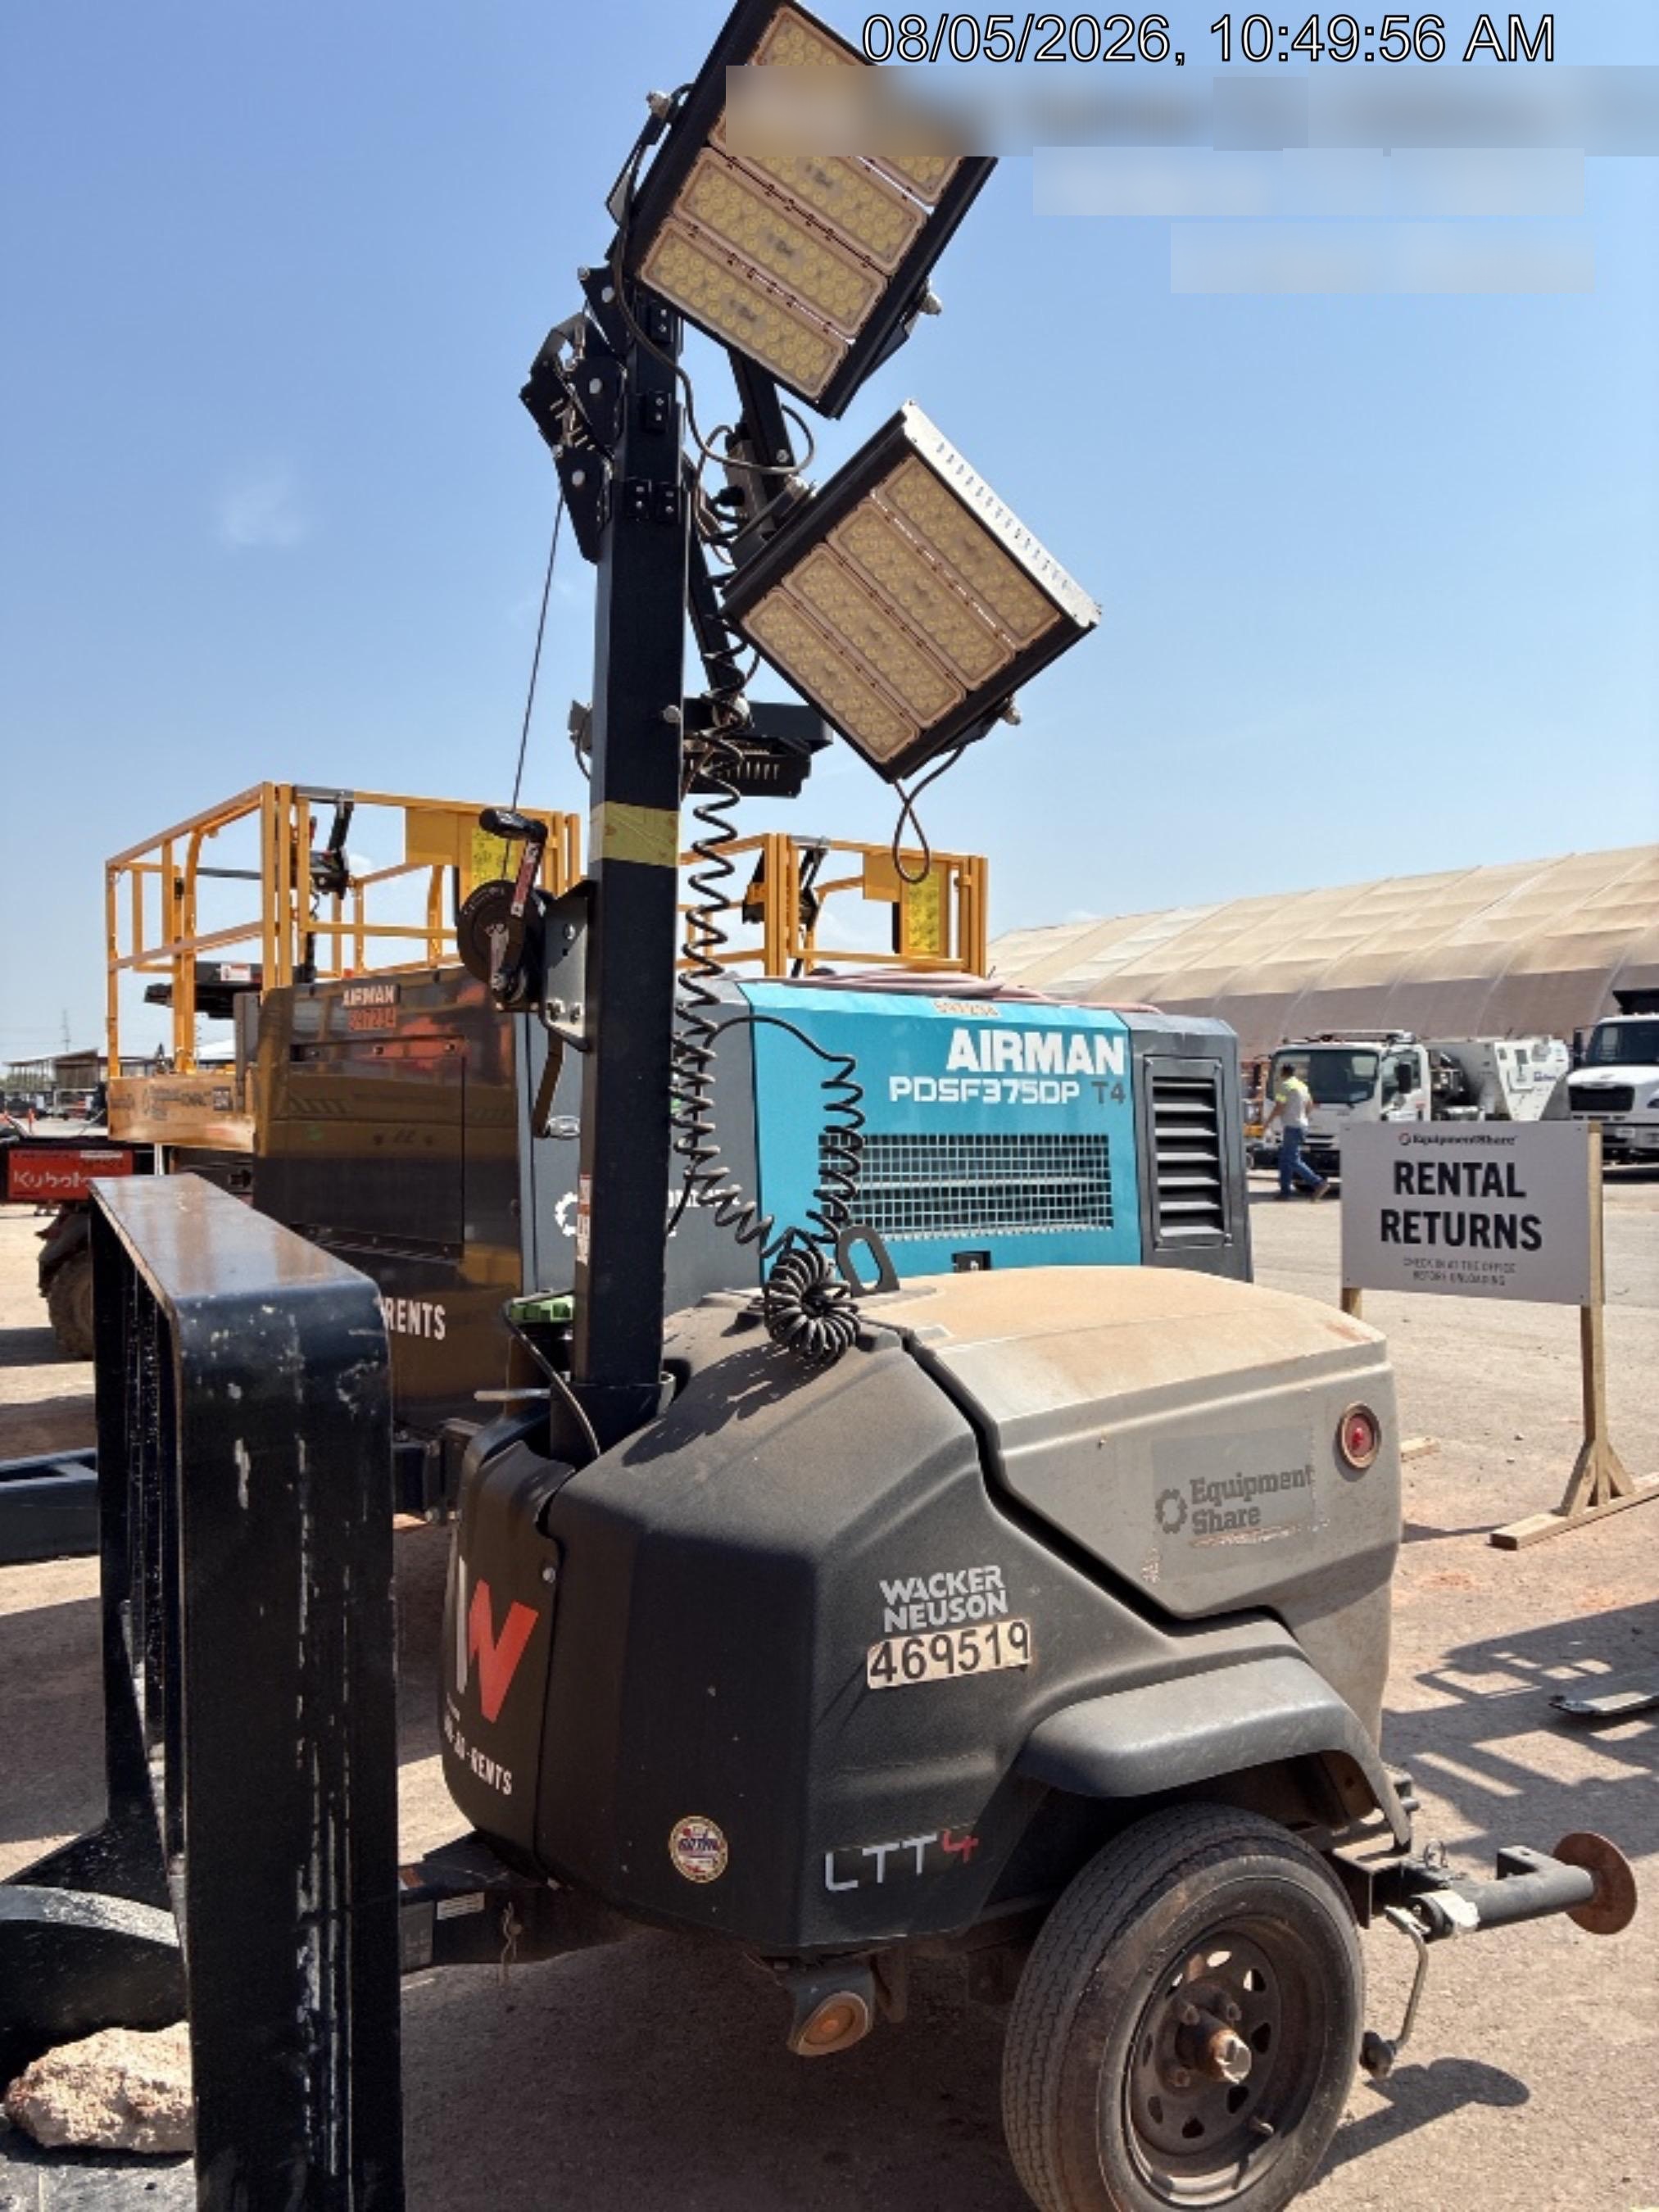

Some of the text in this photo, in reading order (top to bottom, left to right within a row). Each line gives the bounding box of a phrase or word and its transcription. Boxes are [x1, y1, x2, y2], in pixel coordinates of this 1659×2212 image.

[946, 1028, 1126, 1075] AIRMAN
[1090, 1081, 1126, 1105] T4
[1394, 1160, 1528, 1198] RENTAL
[1380, 1209, 1543, 1252] RETURNS
[1190, 1465, 1315, 1507] Equipment
[1191, 1506, 1262, 1535] Share
[879, 1565, 1006, 1607] WACKER
[884, 1590, 1009, 1633] NEUSON
[870, 1620, 1029, 1683] 469519
